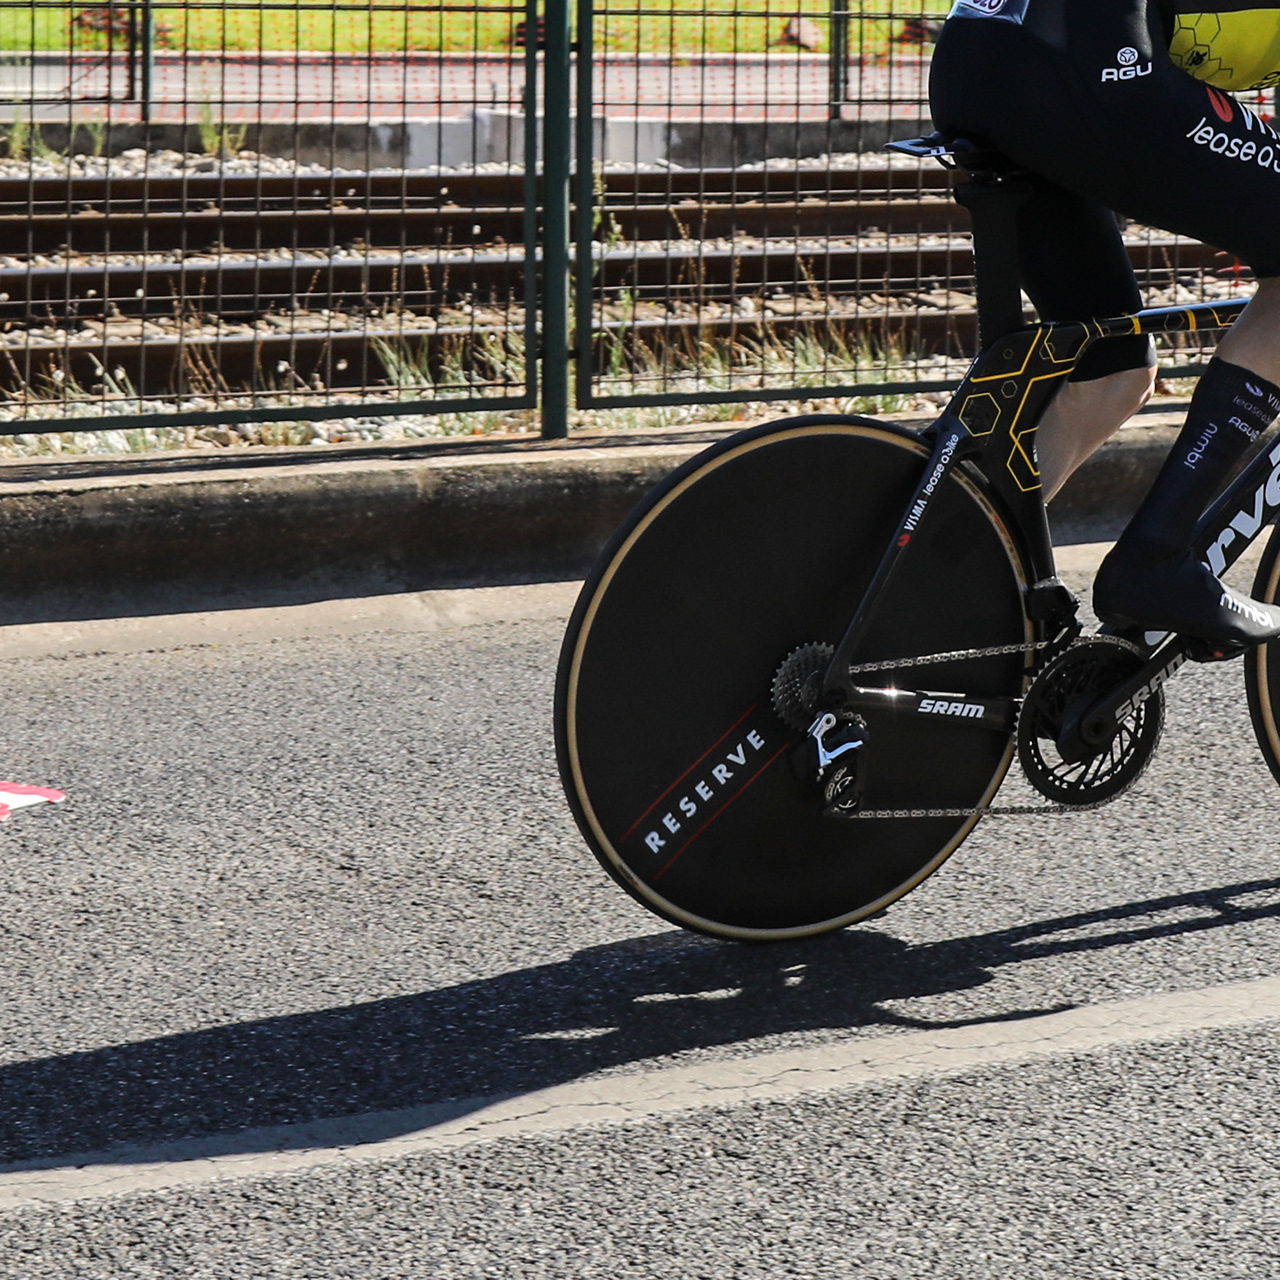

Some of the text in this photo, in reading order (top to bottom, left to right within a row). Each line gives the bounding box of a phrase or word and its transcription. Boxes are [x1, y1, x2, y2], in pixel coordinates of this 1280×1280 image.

[1101, 61, 1152, 82] AGU
[1228, 416, 1254, 440] AGU
[904, 499, 928, 531] VISMA
[918, 699, 985, 719] SRAM
[644, 729, 766, 854] RESERVE
